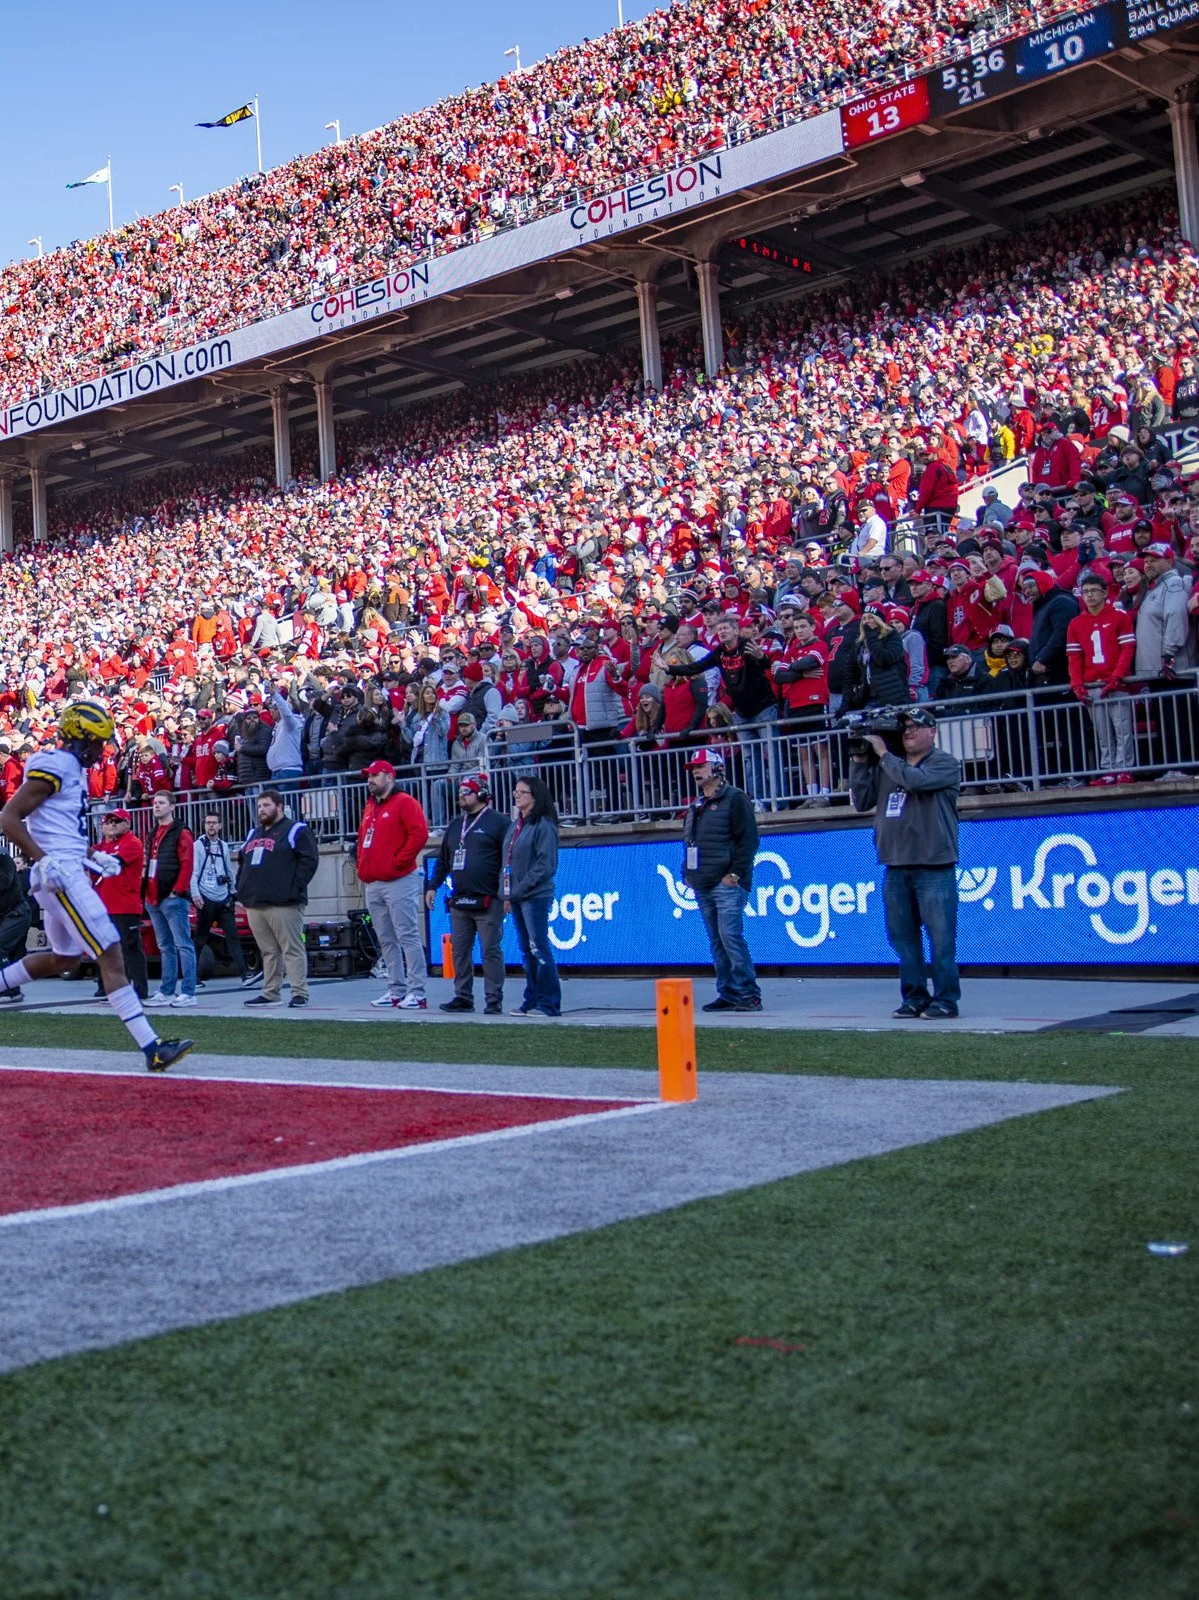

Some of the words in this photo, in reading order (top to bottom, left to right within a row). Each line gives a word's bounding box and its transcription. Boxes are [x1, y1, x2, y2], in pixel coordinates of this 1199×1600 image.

[1128, 1, 1164, 23] BALL
[1128, 19, 1156, 39] 2nd
[1028, 13, 1096, 48] MICHIGAN
[942, 50, 1005, 91] 5:36
[1044, 35, 1085, 71] 10
[848, 98, 877, 117] OHIO
[879, 84, 916, 105] STATE
[957, 80, 987, 105] 21
[867, 105, 901, 137] 13
[570, 155, 722, 230] COHESION
[579, 185, 721, 243] FOUNDATION
[310, 263, 429, 323] COHESION
[318, 289, 428, 335] FOUNDATION
[828, 635, 844, 662] 7
[1090, 629, 1105, 664] 1
